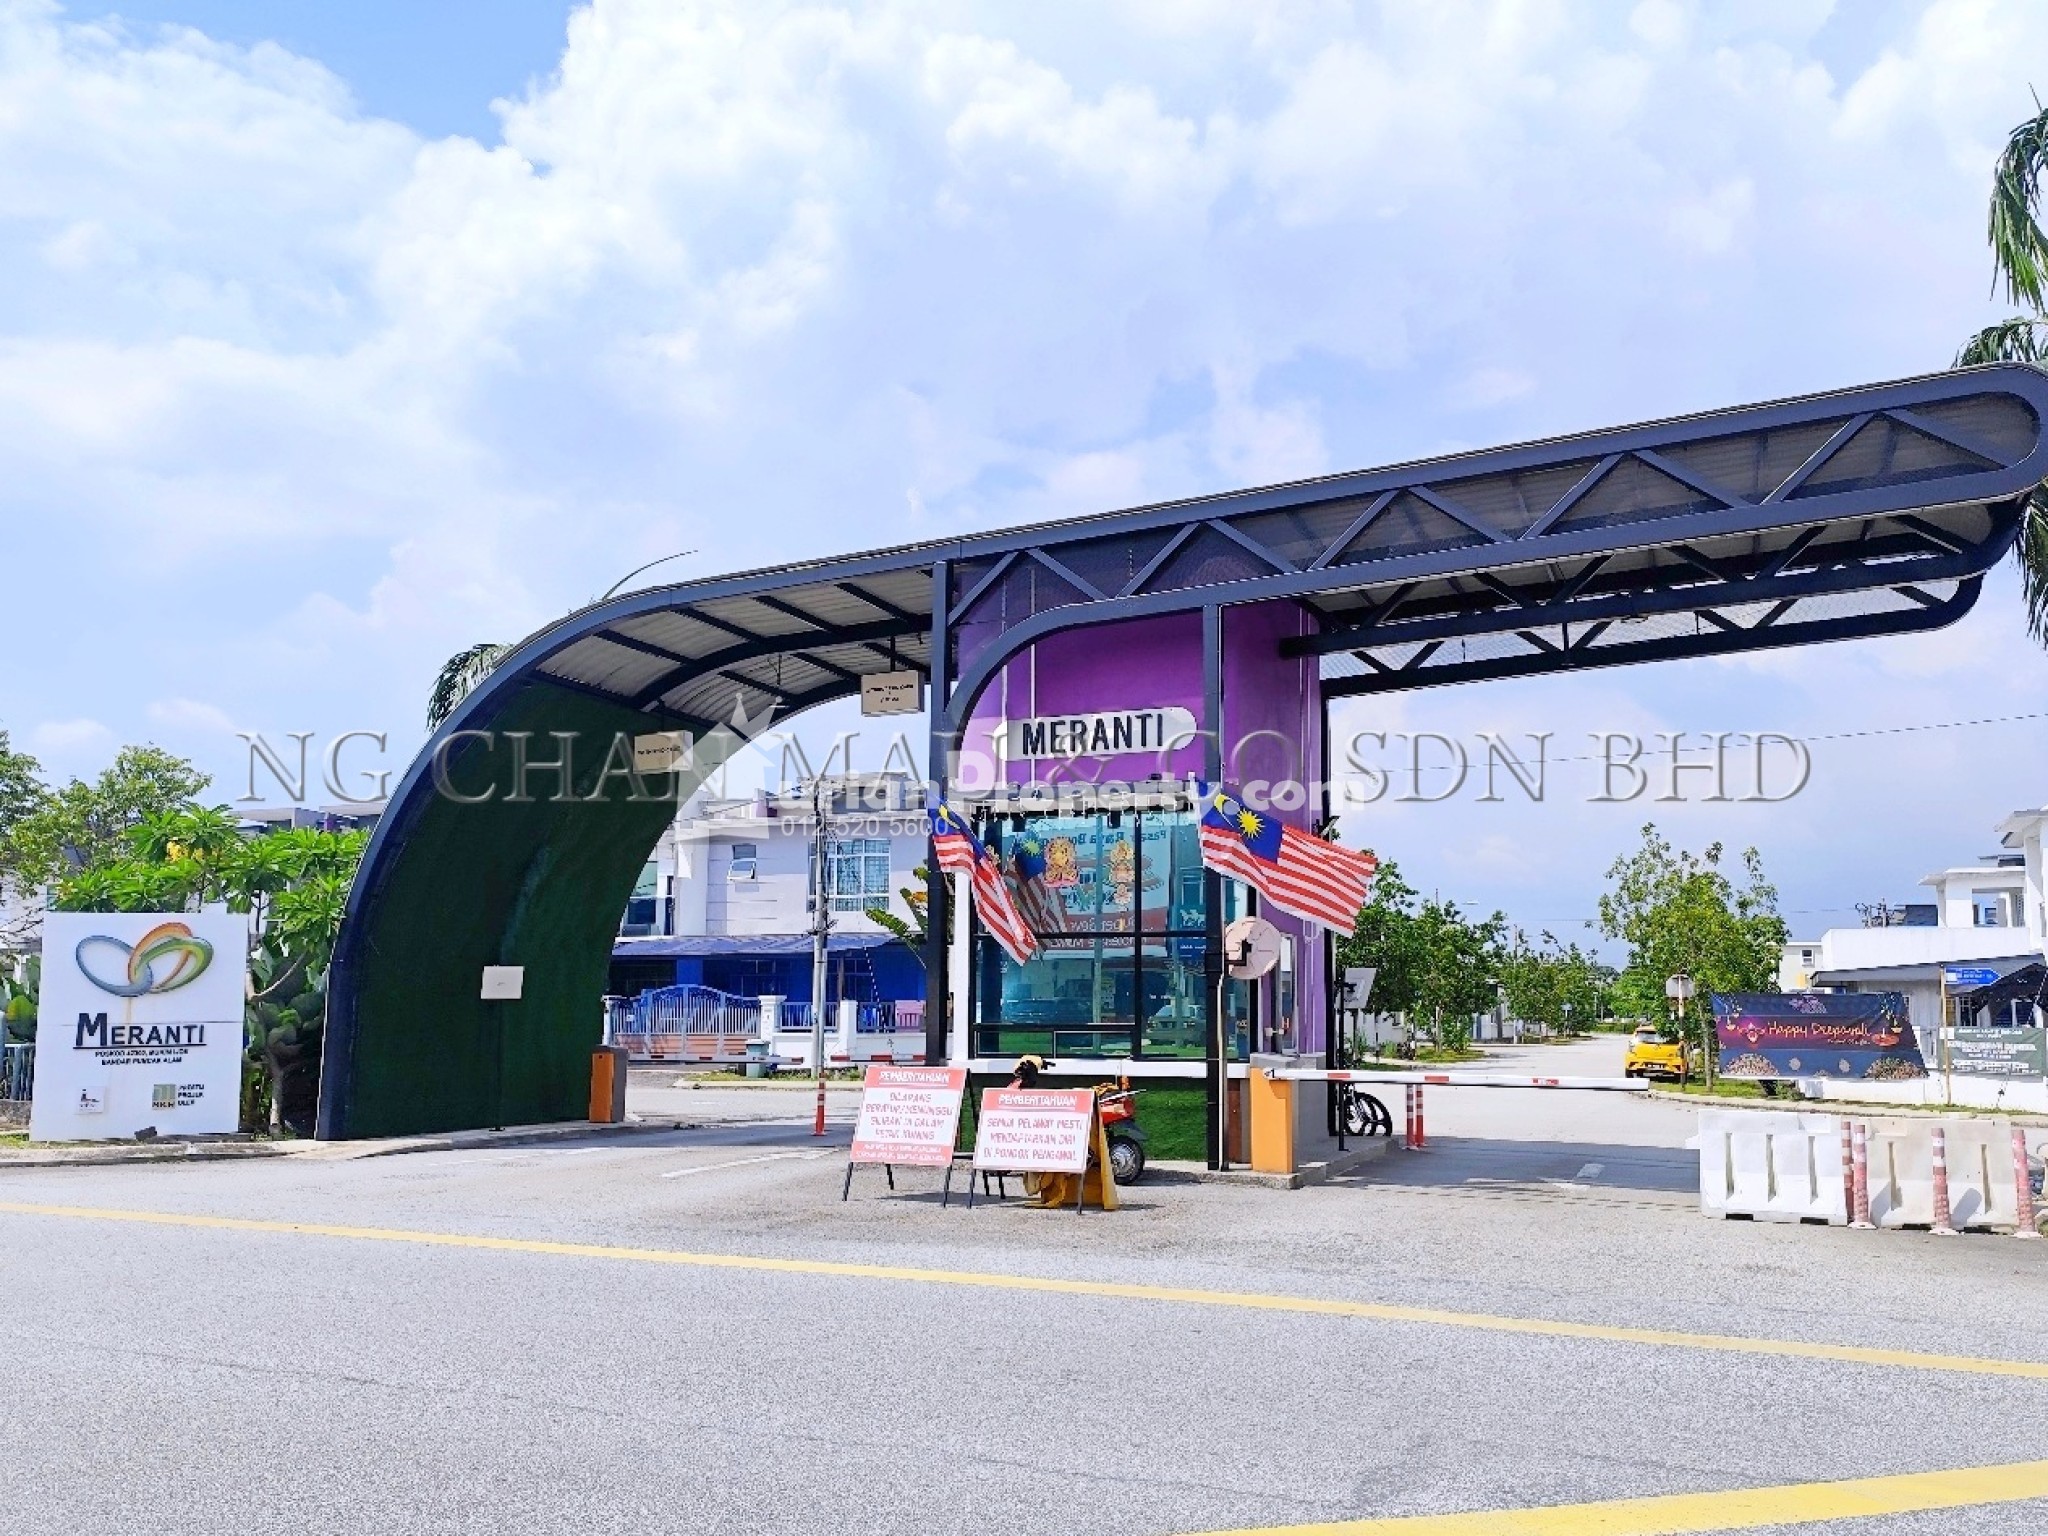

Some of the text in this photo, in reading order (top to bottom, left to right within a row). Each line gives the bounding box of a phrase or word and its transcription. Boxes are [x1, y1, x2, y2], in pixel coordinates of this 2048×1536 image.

[1022, 713, 1164, 756] MERANTI
[76, 1012, 205, 1046] MERANTI
[1768, 1021, 1868, 1039] Happy Deepavali
[998, 1093, 1077, 1107] PEMBERITAHUAN
[987, 1118, 1014, 1127] SEMUA
[1056, 1119, 1083, 1130] MESTI
